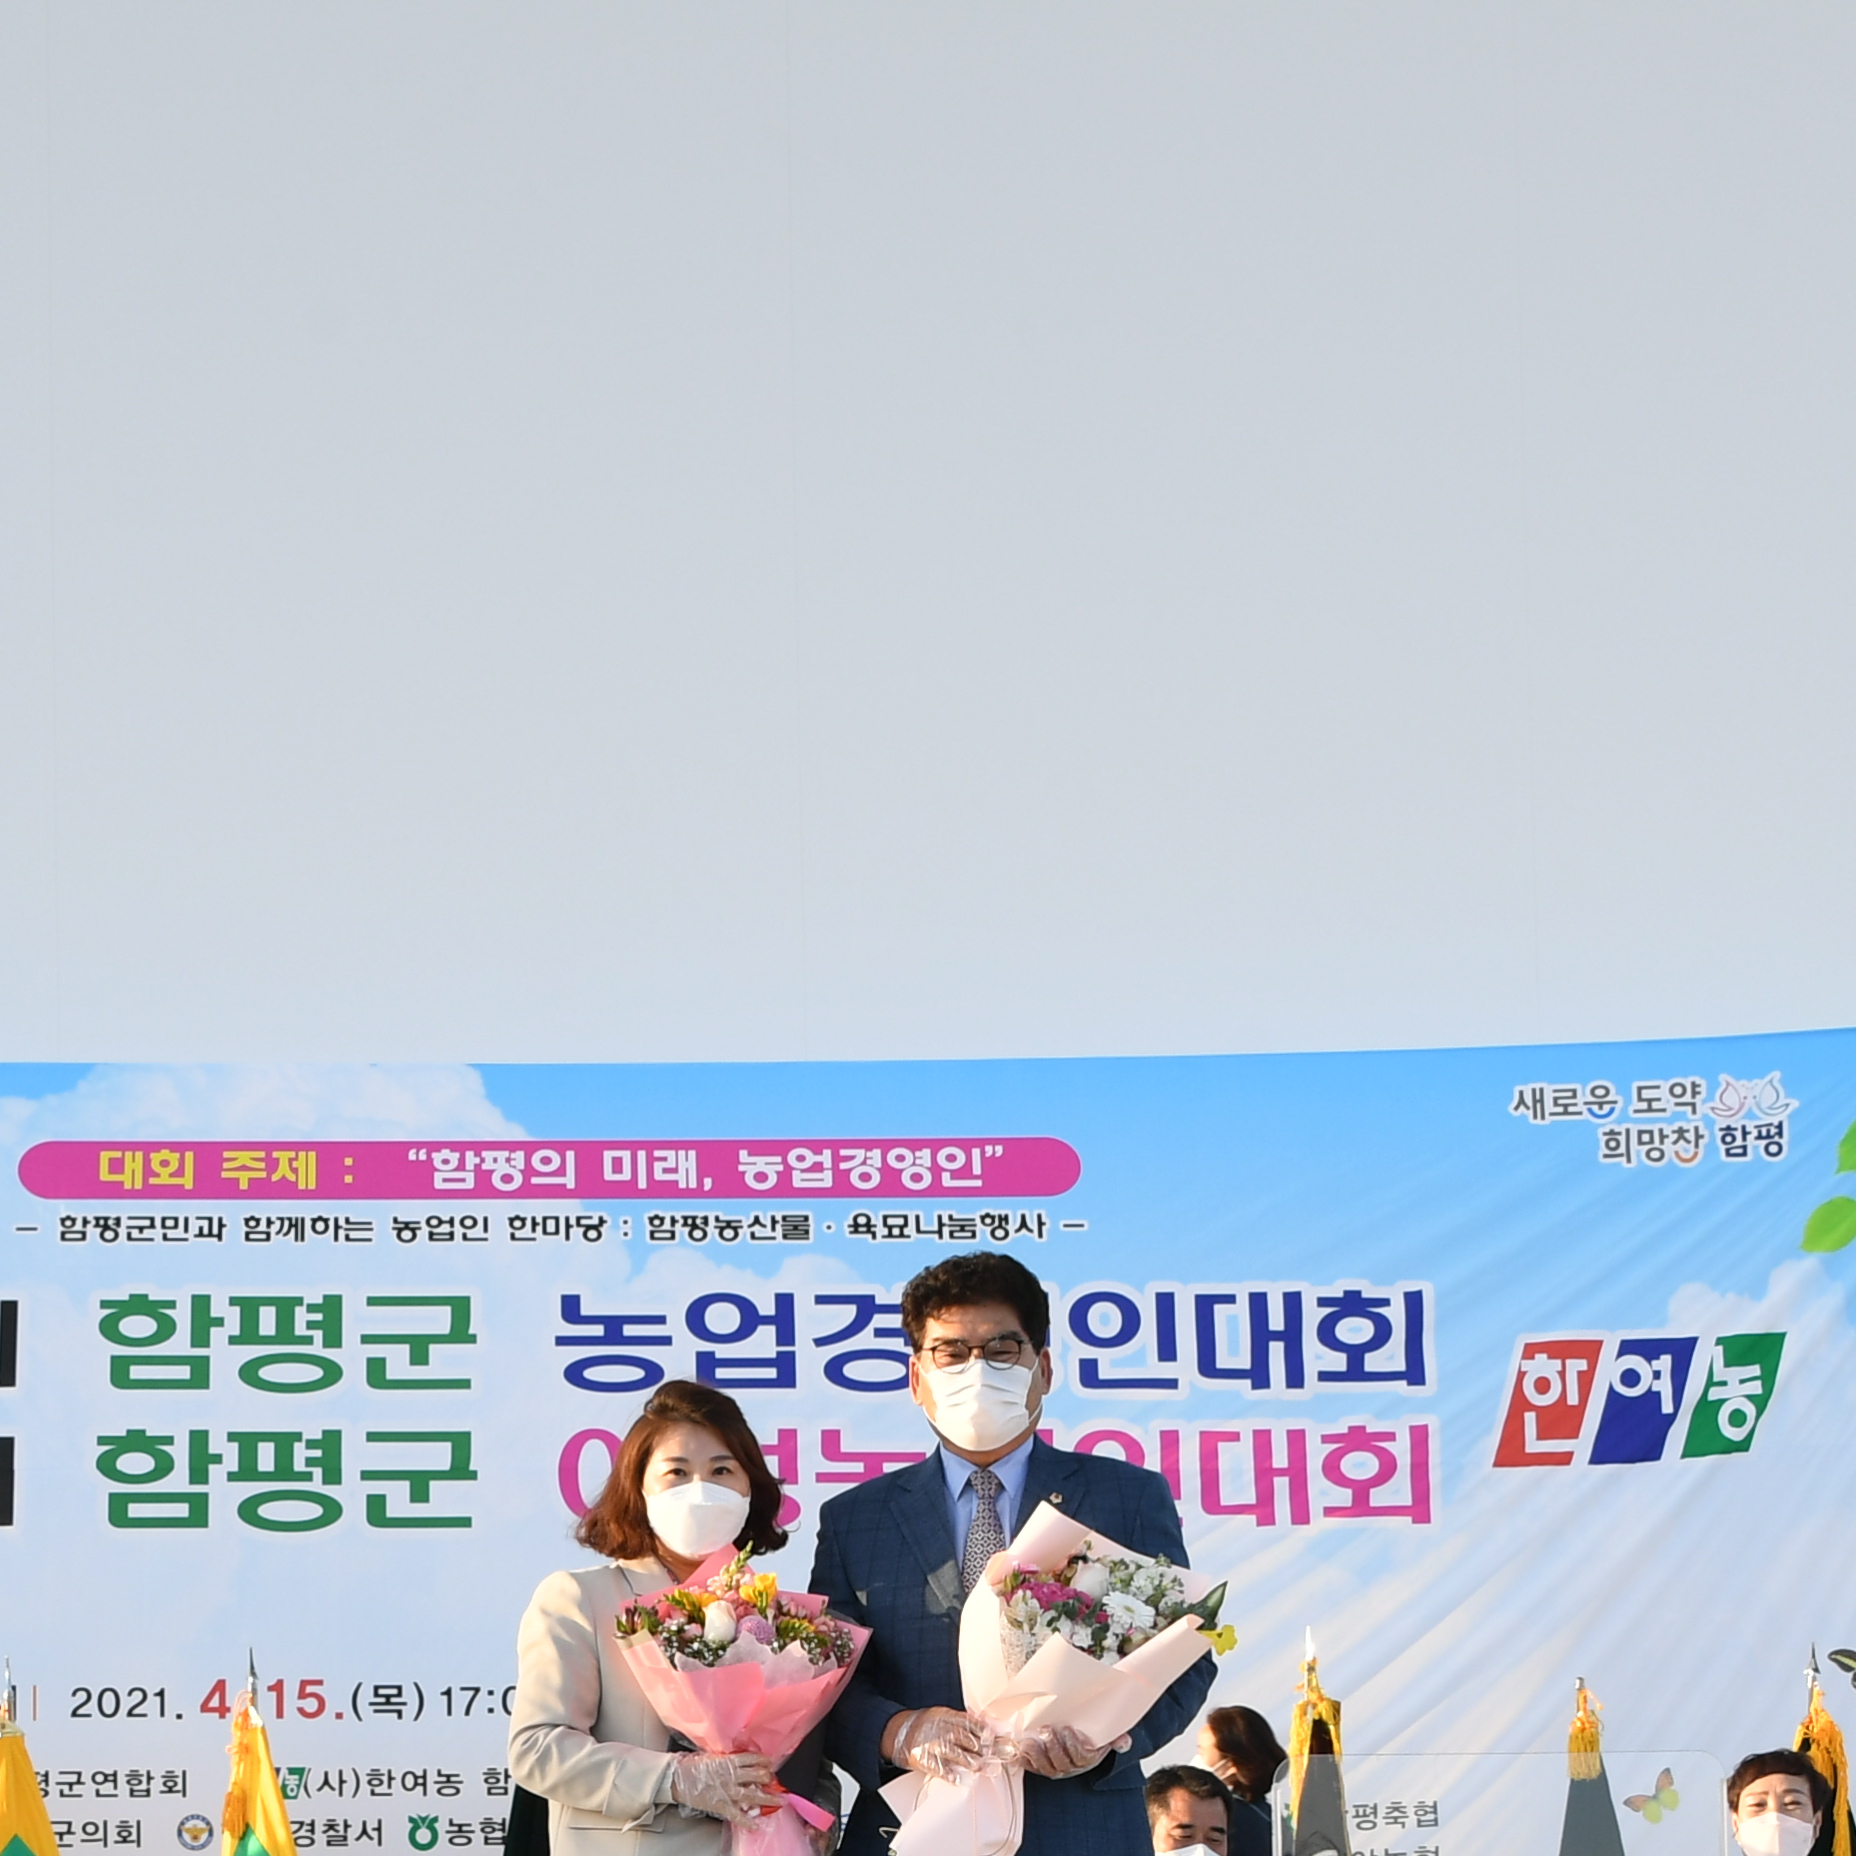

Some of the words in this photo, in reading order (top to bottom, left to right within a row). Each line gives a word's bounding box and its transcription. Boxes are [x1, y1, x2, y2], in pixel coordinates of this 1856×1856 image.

[1513, 1084, 1619, 1121] 새로운
[1632, 1080, 1703, 1117] 도약
[1601, 1125, 1705, 1164] 희망찬
[1717, 1120, 1785, 1158] 함평
[98, 1148, 196, 1191] 대회
[219, 1148, 318, 1191] 주제
[602, 1148, 714, 1192] 미래,
[58, 1214, 227, 1244] 함평군민과
[242, 1214, 375, 1244] 함께하는
[390, 1214, 490, 1243] 농업인
[506, 1213, 608, 1243] 한마당
[646, 1213, 812, 1243] 함평농산물
[846, 1211, 1048, 1243] 육묘나눔행사
[94, 1291, 480, 1395] 함평군
[553, 1288, 1428, 1394] 농업경인대회
[1519, 1343, 1764, 1454] 한여농
[94, 1426, 480, 1532] 함평군
[69, 1687, 185, 1720] 2021.
[1345, 1800, 1440, 1831] 평축협
